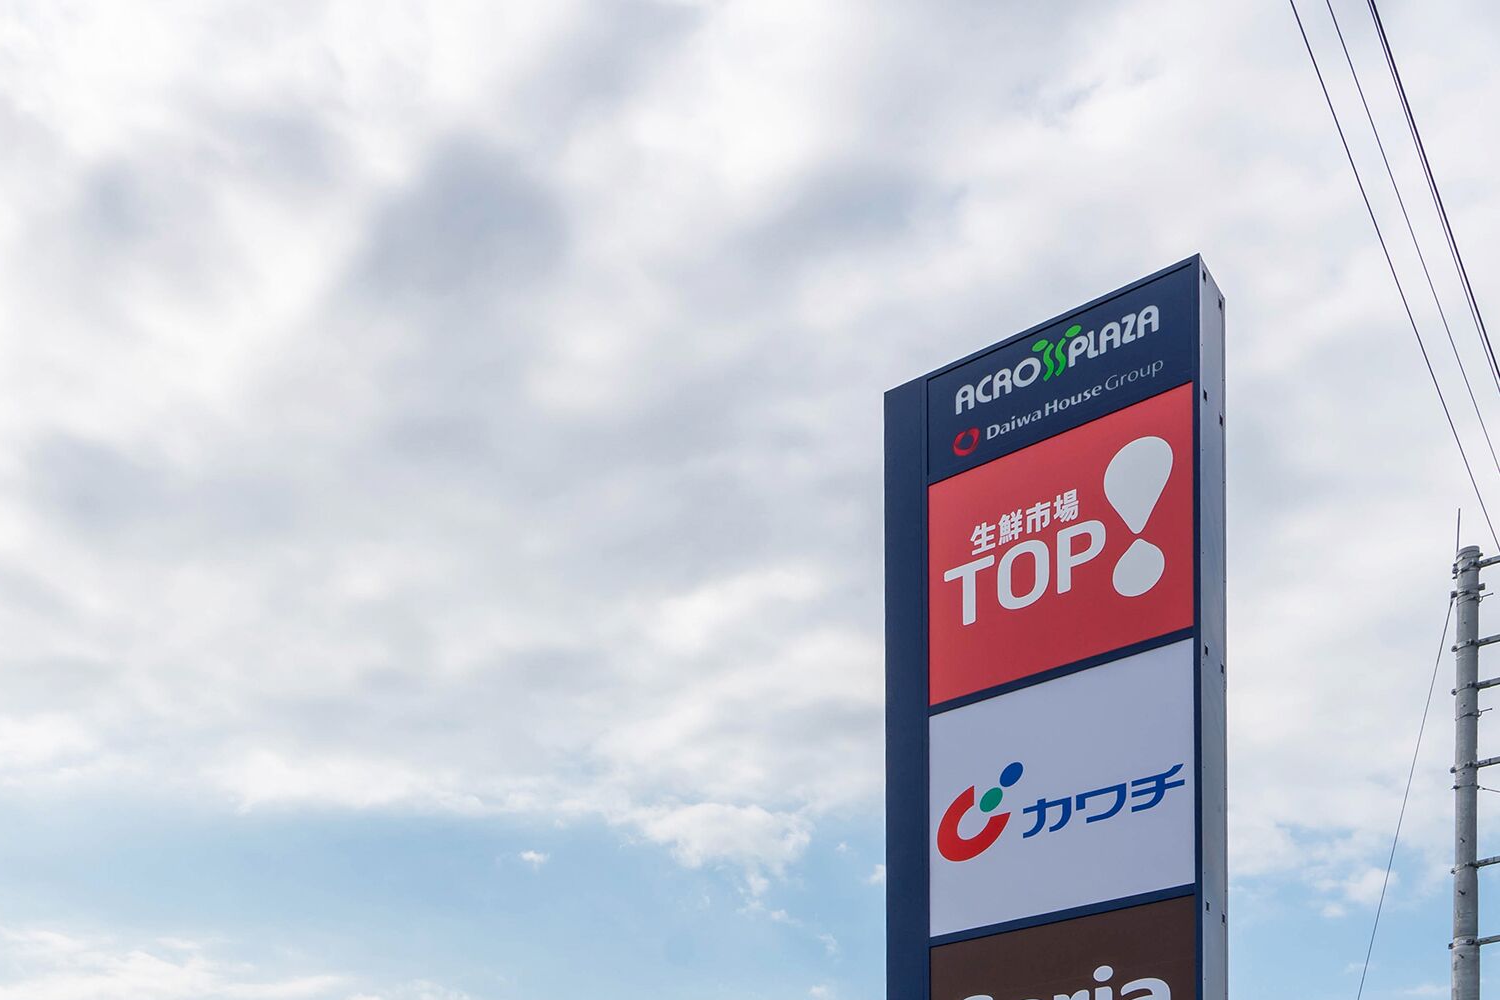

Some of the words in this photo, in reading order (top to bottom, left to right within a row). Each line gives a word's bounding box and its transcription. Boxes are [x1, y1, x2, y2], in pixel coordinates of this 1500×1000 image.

[986, 408, 1042, 440] Daiwa
[1044, 383, 1103, 417] House
[1104, 359, 1164, 391] Group
[970, 489, 1079, 556] 生鮮市場
[1022, 763, 1185, 839] カワチ
